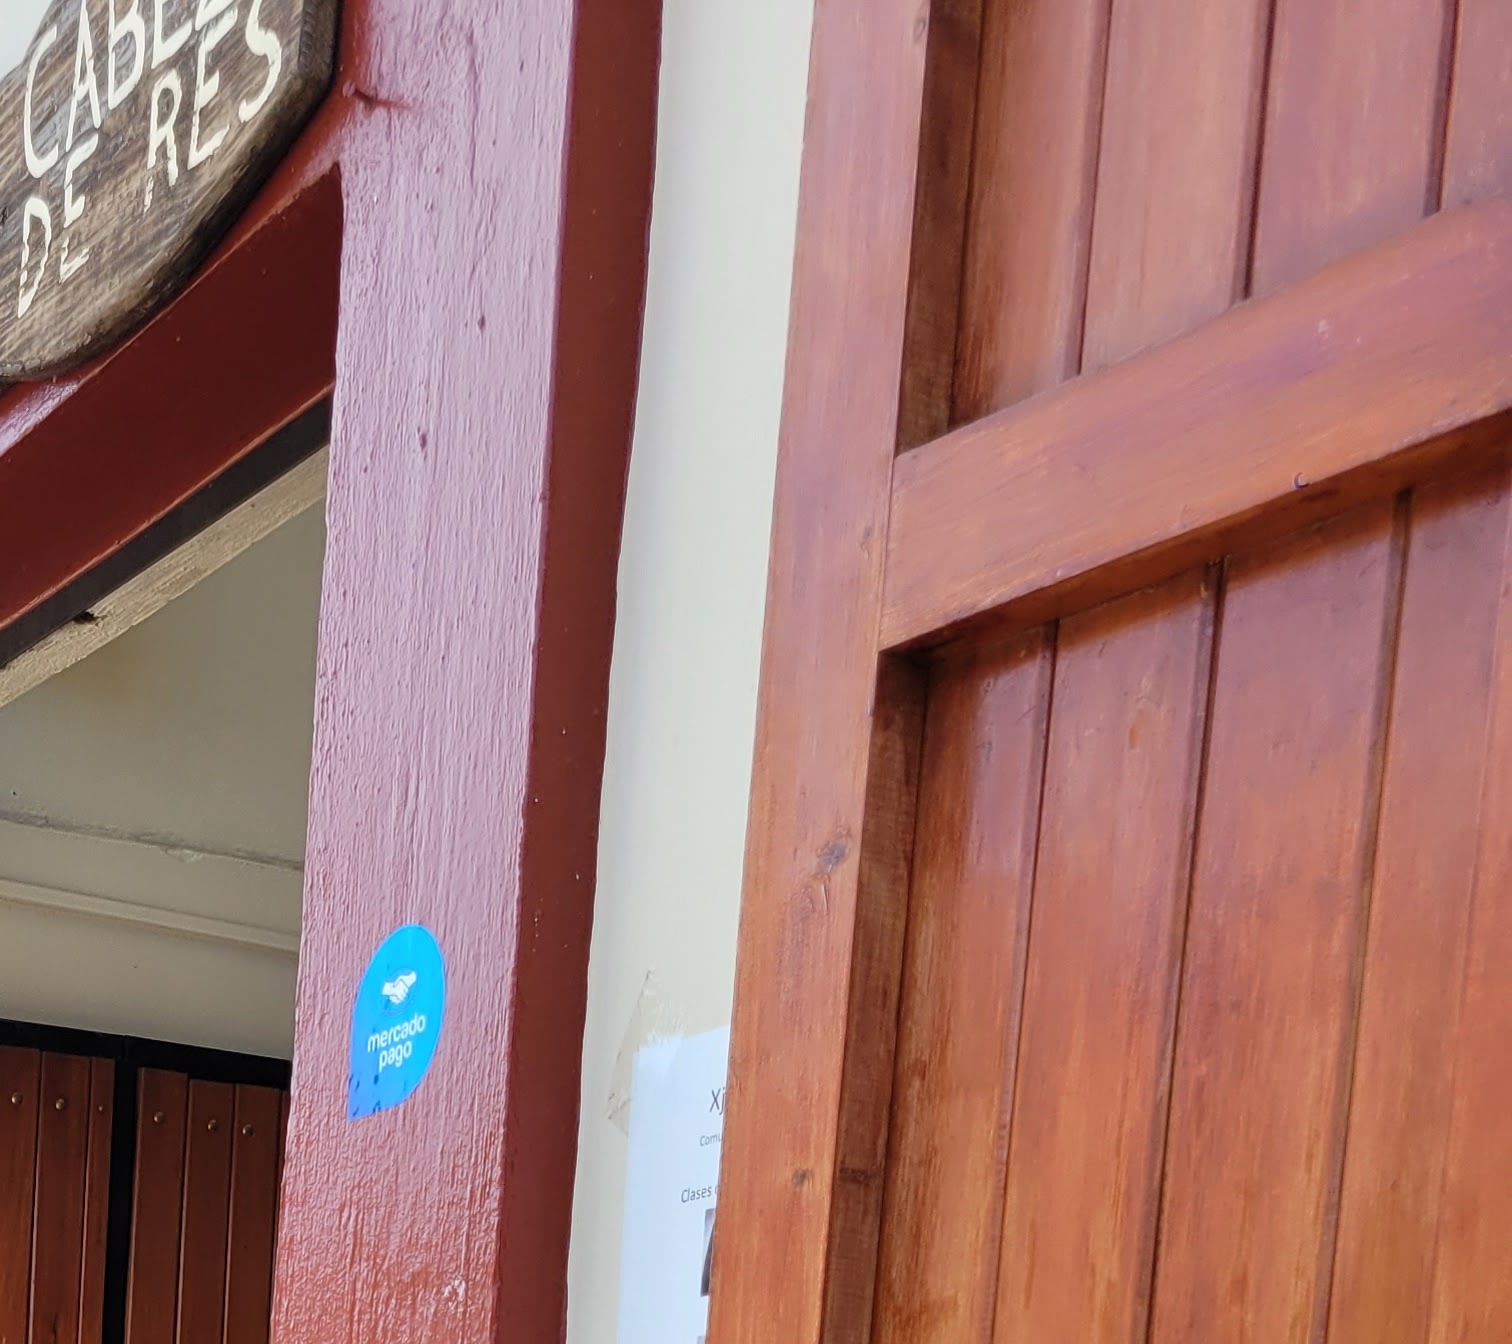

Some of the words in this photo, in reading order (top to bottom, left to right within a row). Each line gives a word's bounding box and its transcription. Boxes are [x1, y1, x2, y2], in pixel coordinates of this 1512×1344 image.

[18, 134, 98, 319] DE
[143, 0, 282, 214] RES
[367, 1014, 426, 1053] mercado
[378, 1040, 412, 1073] pago
[681, 1185, 713, 1203] Clases
